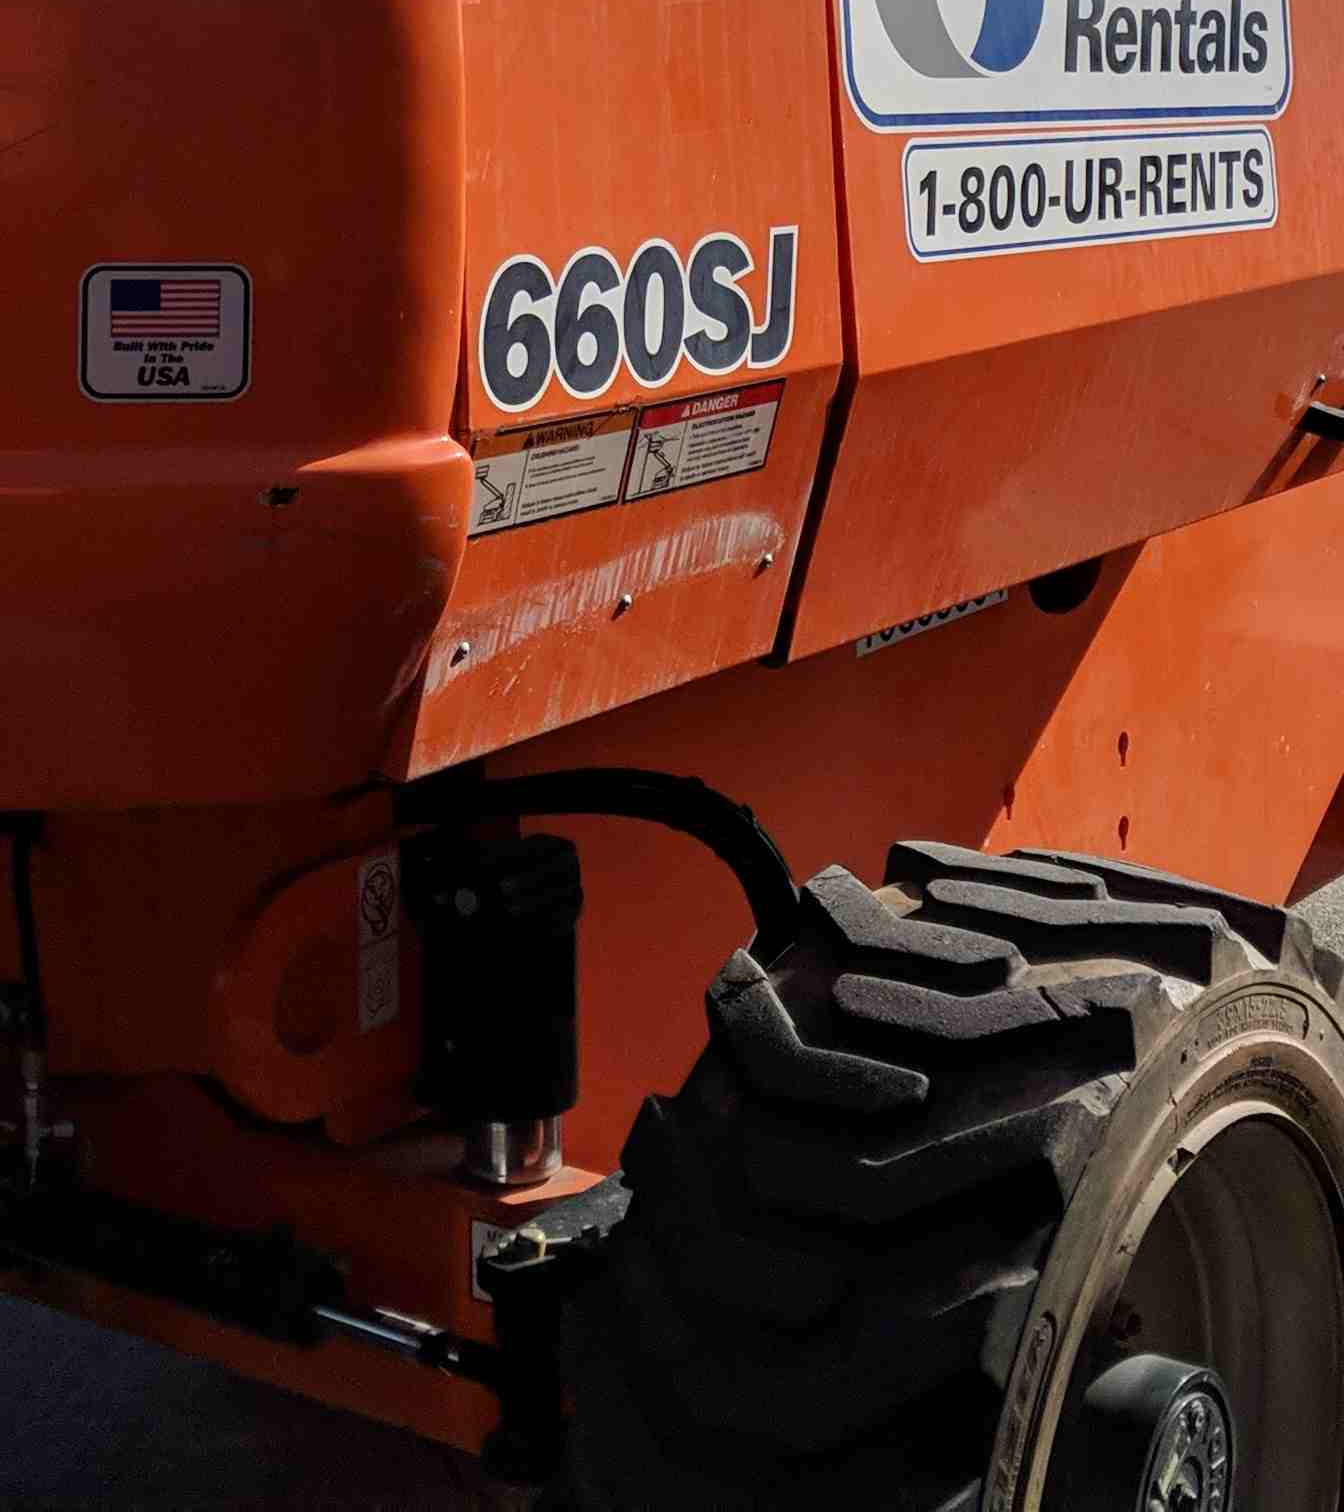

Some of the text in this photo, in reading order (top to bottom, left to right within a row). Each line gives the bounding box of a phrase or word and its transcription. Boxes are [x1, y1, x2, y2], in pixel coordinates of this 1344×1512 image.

[918, 147, 1266, 237] 1-800-UR-RENTS
[480, 226, 798, 411] 660SJ
[137, 365, 191, 387] USA
[691, 393, 740, 416] DANGER
